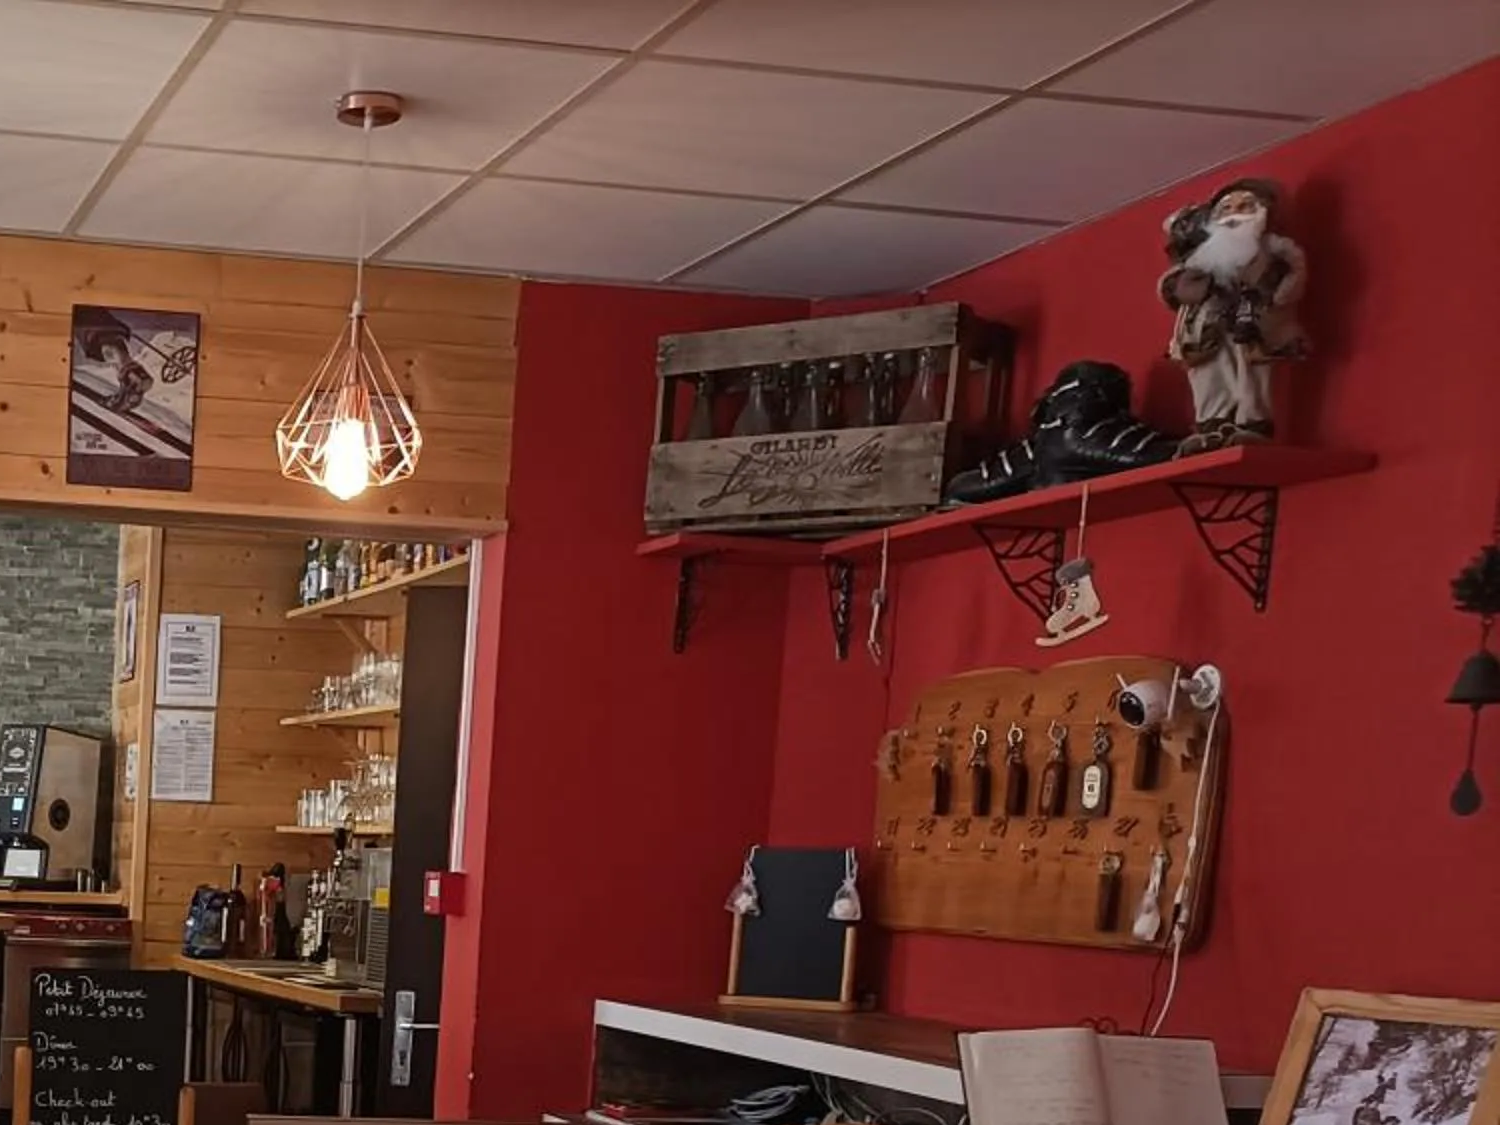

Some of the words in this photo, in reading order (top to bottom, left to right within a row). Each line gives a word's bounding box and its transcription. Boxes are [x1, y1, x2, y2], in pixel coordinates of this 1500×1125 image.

[34, 973, 75, 998] Petit
[35, 1087, 85, 1109] Check
[89, 1089, 117, 1108] out
